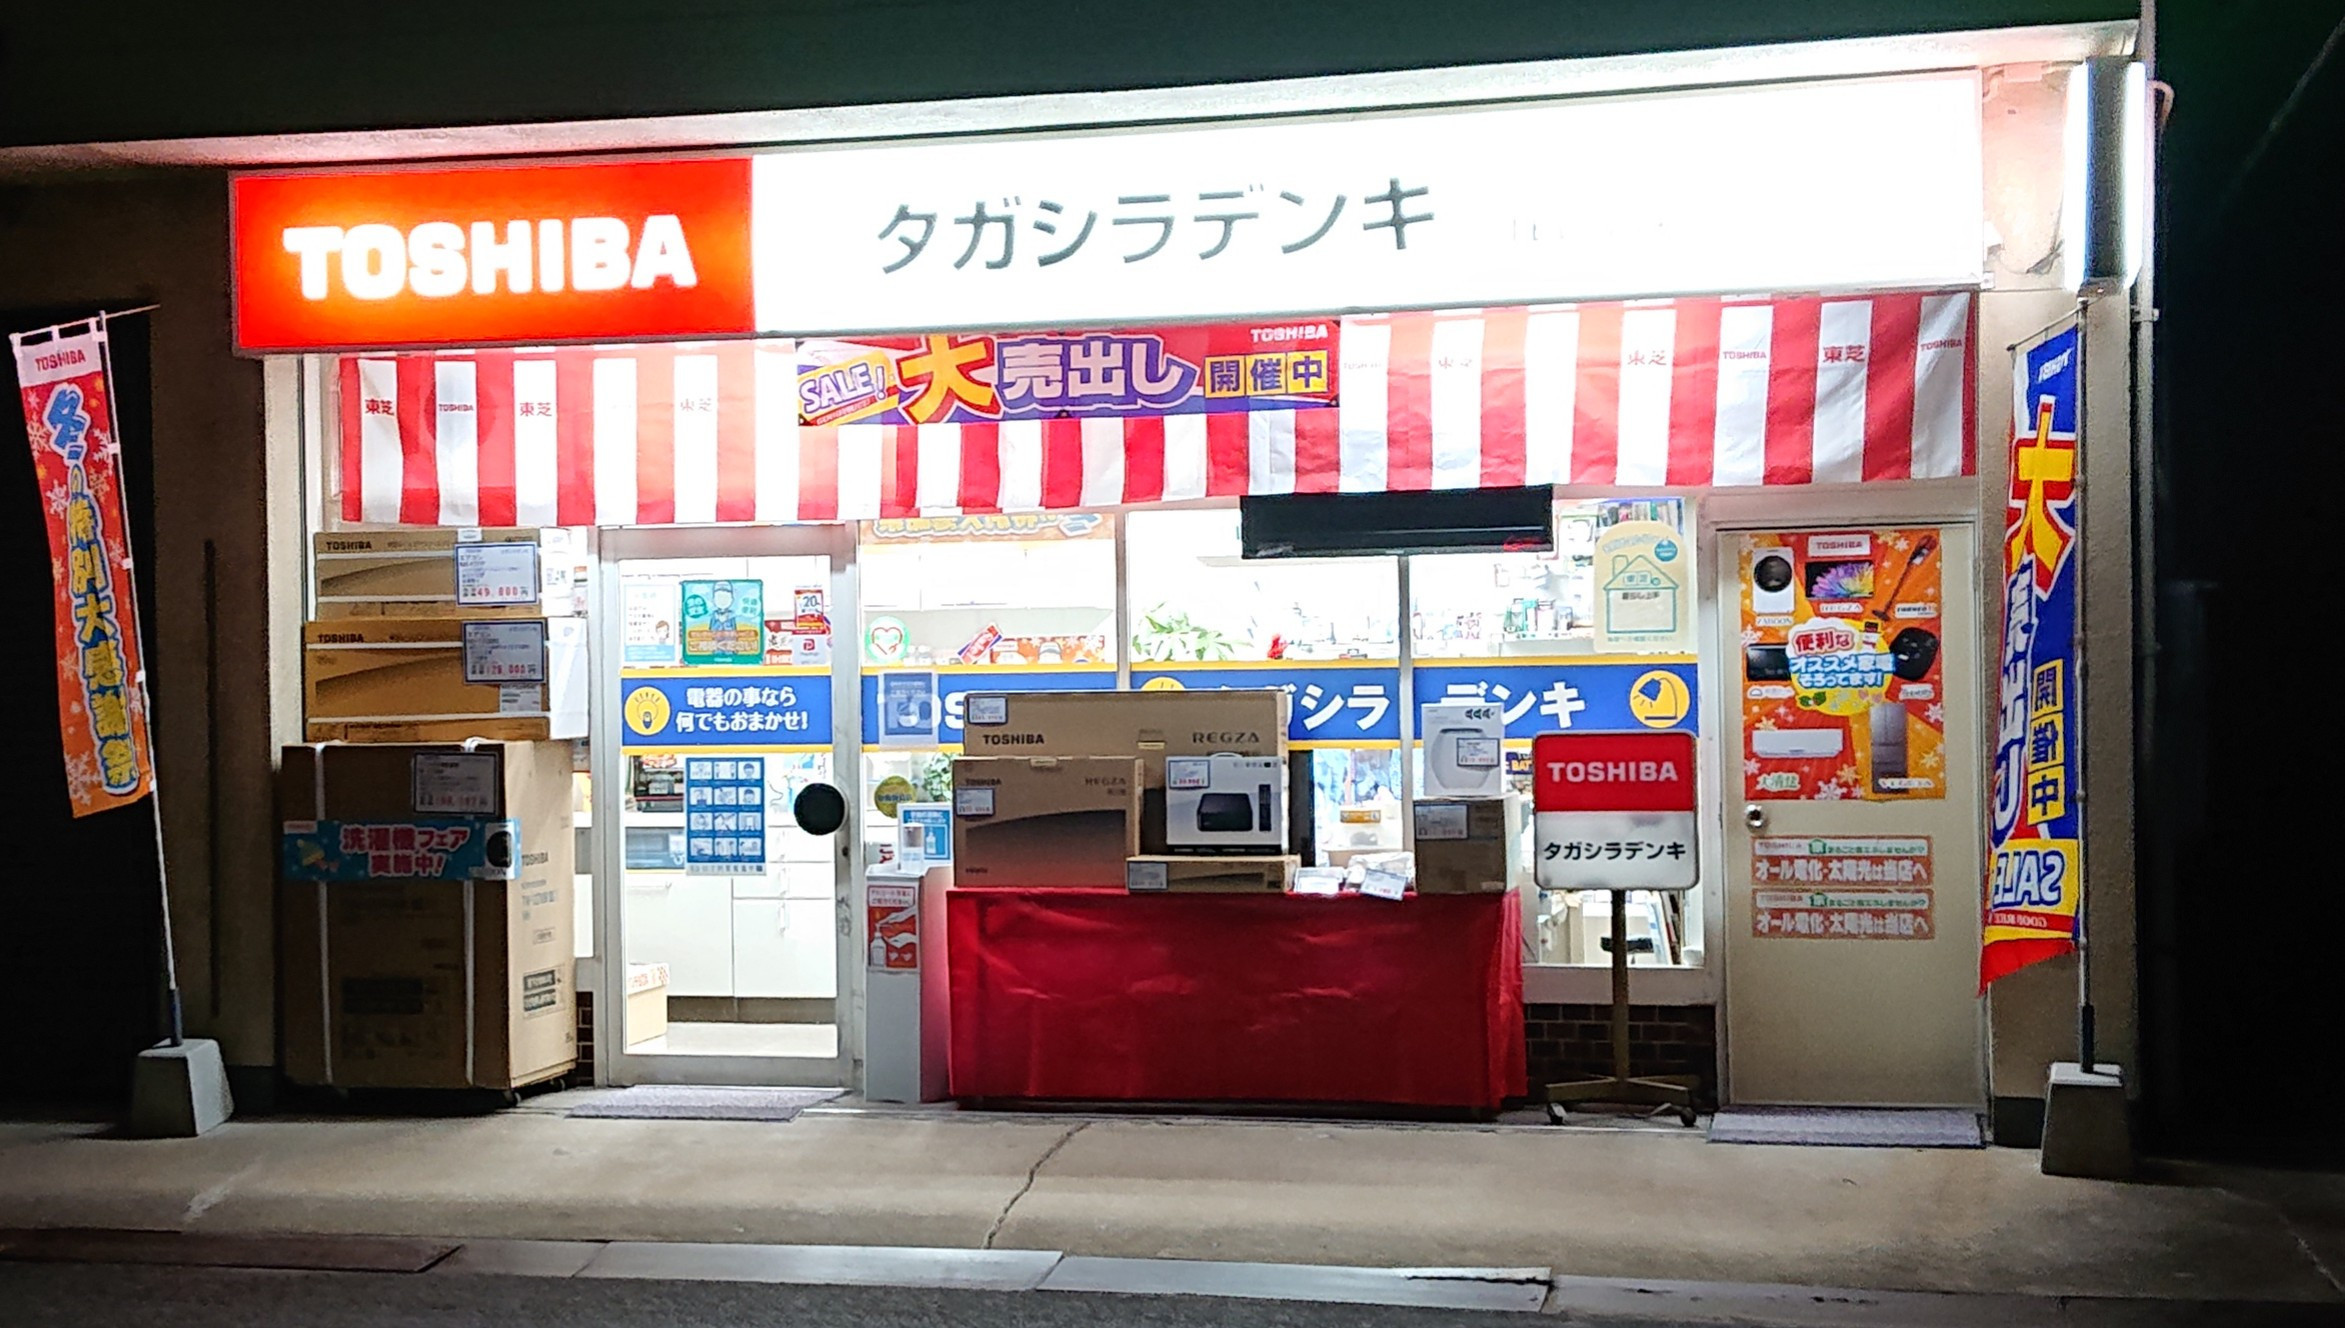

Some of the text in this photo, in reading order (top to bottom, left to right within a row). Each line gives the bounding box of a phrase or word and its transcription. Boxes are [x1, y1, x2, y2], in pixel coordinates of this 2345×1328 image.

[877, 176, 1436, 275] タガシラデンキ
[283, 214, 697, 301] TOSHIBA
[1250, 324, 1329, 345] TOSHIBA
[1920, 336, 1963, 353] TOSHIBA
[35, 349, 86, 372] TOSHIBA
[1723, 350, 1767, 360] TOSHIBA
[1823, 345, 1865, 364] 東芝
[899, 334, 1183, 424] 大売出し
[1208, 352, 1326, 395] 開催中
[799, 359, 885, 414] SALE!
[364, 399, 394, 417] 東芝
[438, 403, 474, 413] TOSHIBA
[519, 401, 552, 417] 東芝
[326, 541, 372, 550] TOSHIBA
[1815, 541, 1863, 550] TOSHIBA
[318, 634, 364, 643] TOSHIBA
[1795, 630, 1851, 651] 便利な
[1791, 655, 1894, 672] オススメ家電
[1799, 673, 1884, 687] そろってます!
[687, 687, 796, 708] 電器の事なら
[676, 711, 808, 733] 何でもおまかせ!
[983, 734, 1045, 745] TOSHIBA
[1193, 731, 1260, 744] REGZA
[965, 778, 1001, 786] TOSHIBA
[1085, 777, 1126, 786] REGZA
[1547, 761, 1678, 783] TOSHIBA
[342, 826, 469, 850] 洗濯機フェア
[1544, 841, 1686, 861] タガシラデンキ
[371, 853, 445, 875] 実施中!
[1756, 858, 1929, 882] オール電化・太陽光は当店へ
[1757, 912, 1930, 935] オール電化・太陽光は当店へ
